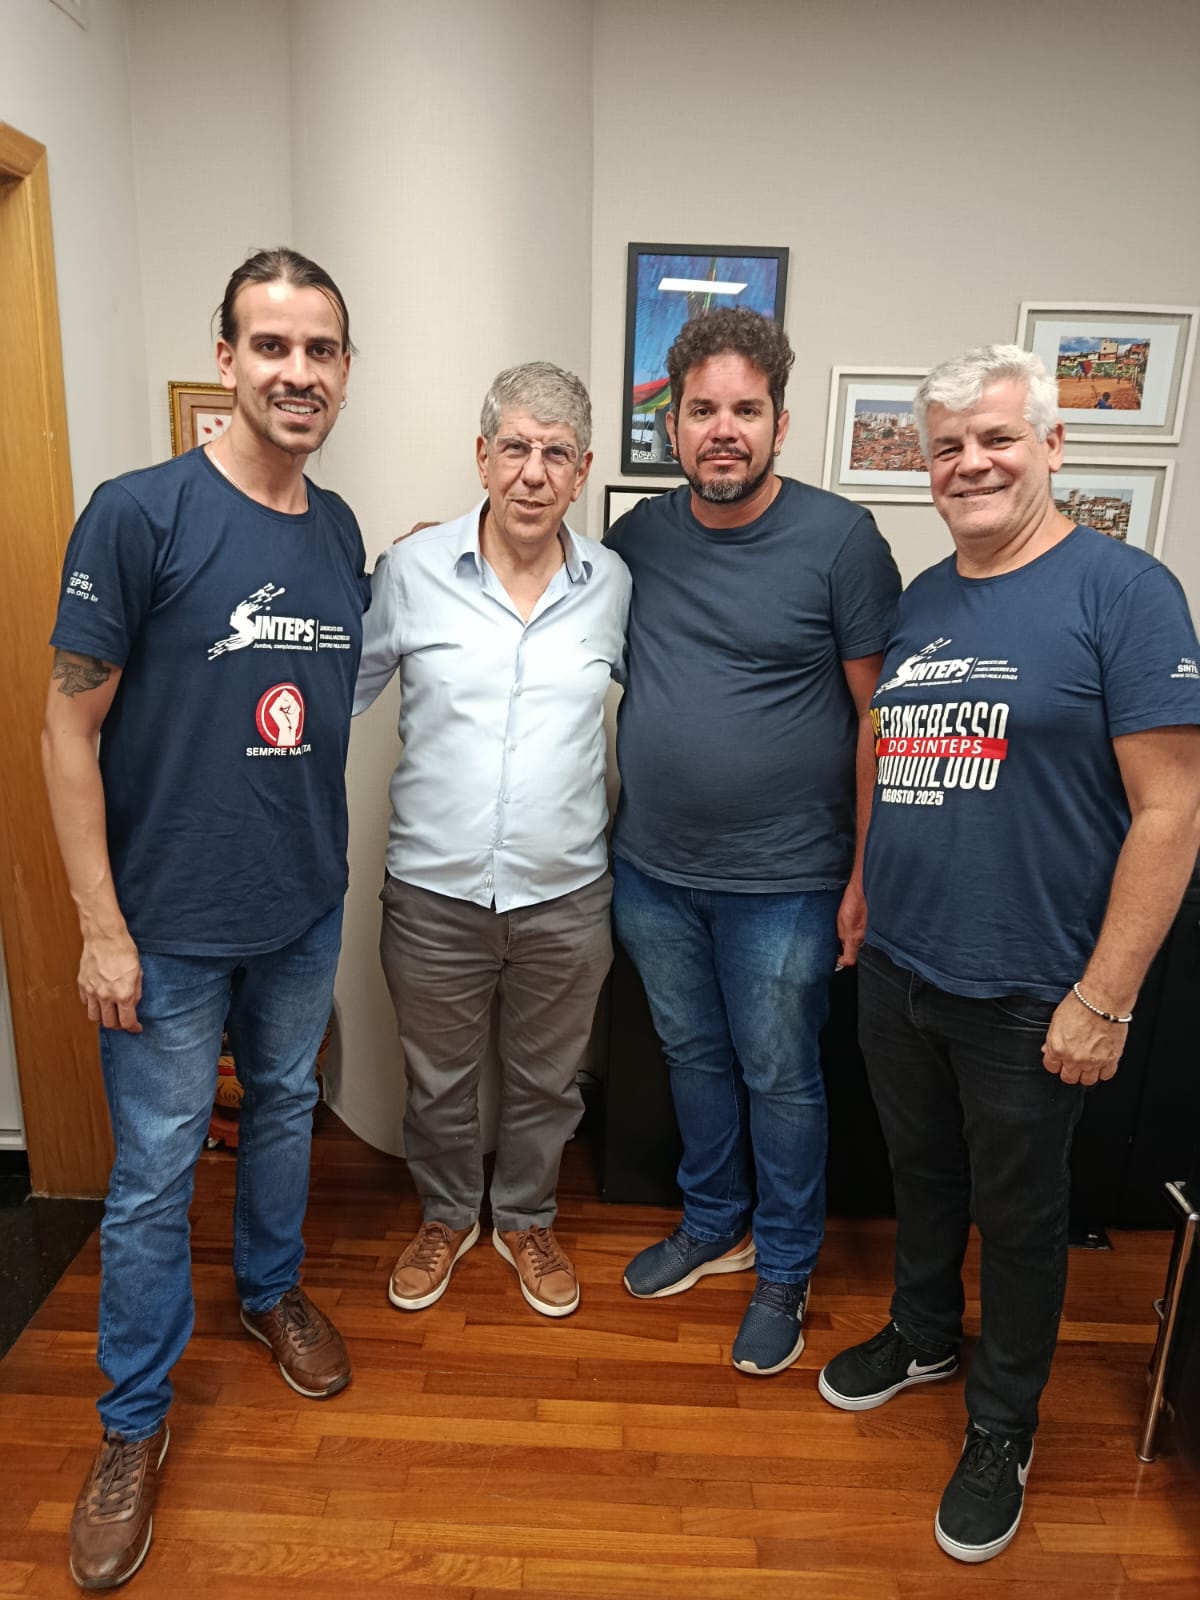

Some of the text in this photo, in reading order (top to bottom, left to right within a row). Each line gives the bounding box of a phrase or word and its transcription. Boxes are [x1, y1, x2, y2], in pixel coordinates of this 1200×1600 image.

[222, 600, 316, 650] SINTEPS
[880, 650, 975, 692] SINTEPS
[246, 747, 287, 757] SEMPRE
[289, 747, 302, 756] NA
[888, 738, 984, 755] DO SINTEPS
[881, 788, 945, 806] AGOSTO 2025
